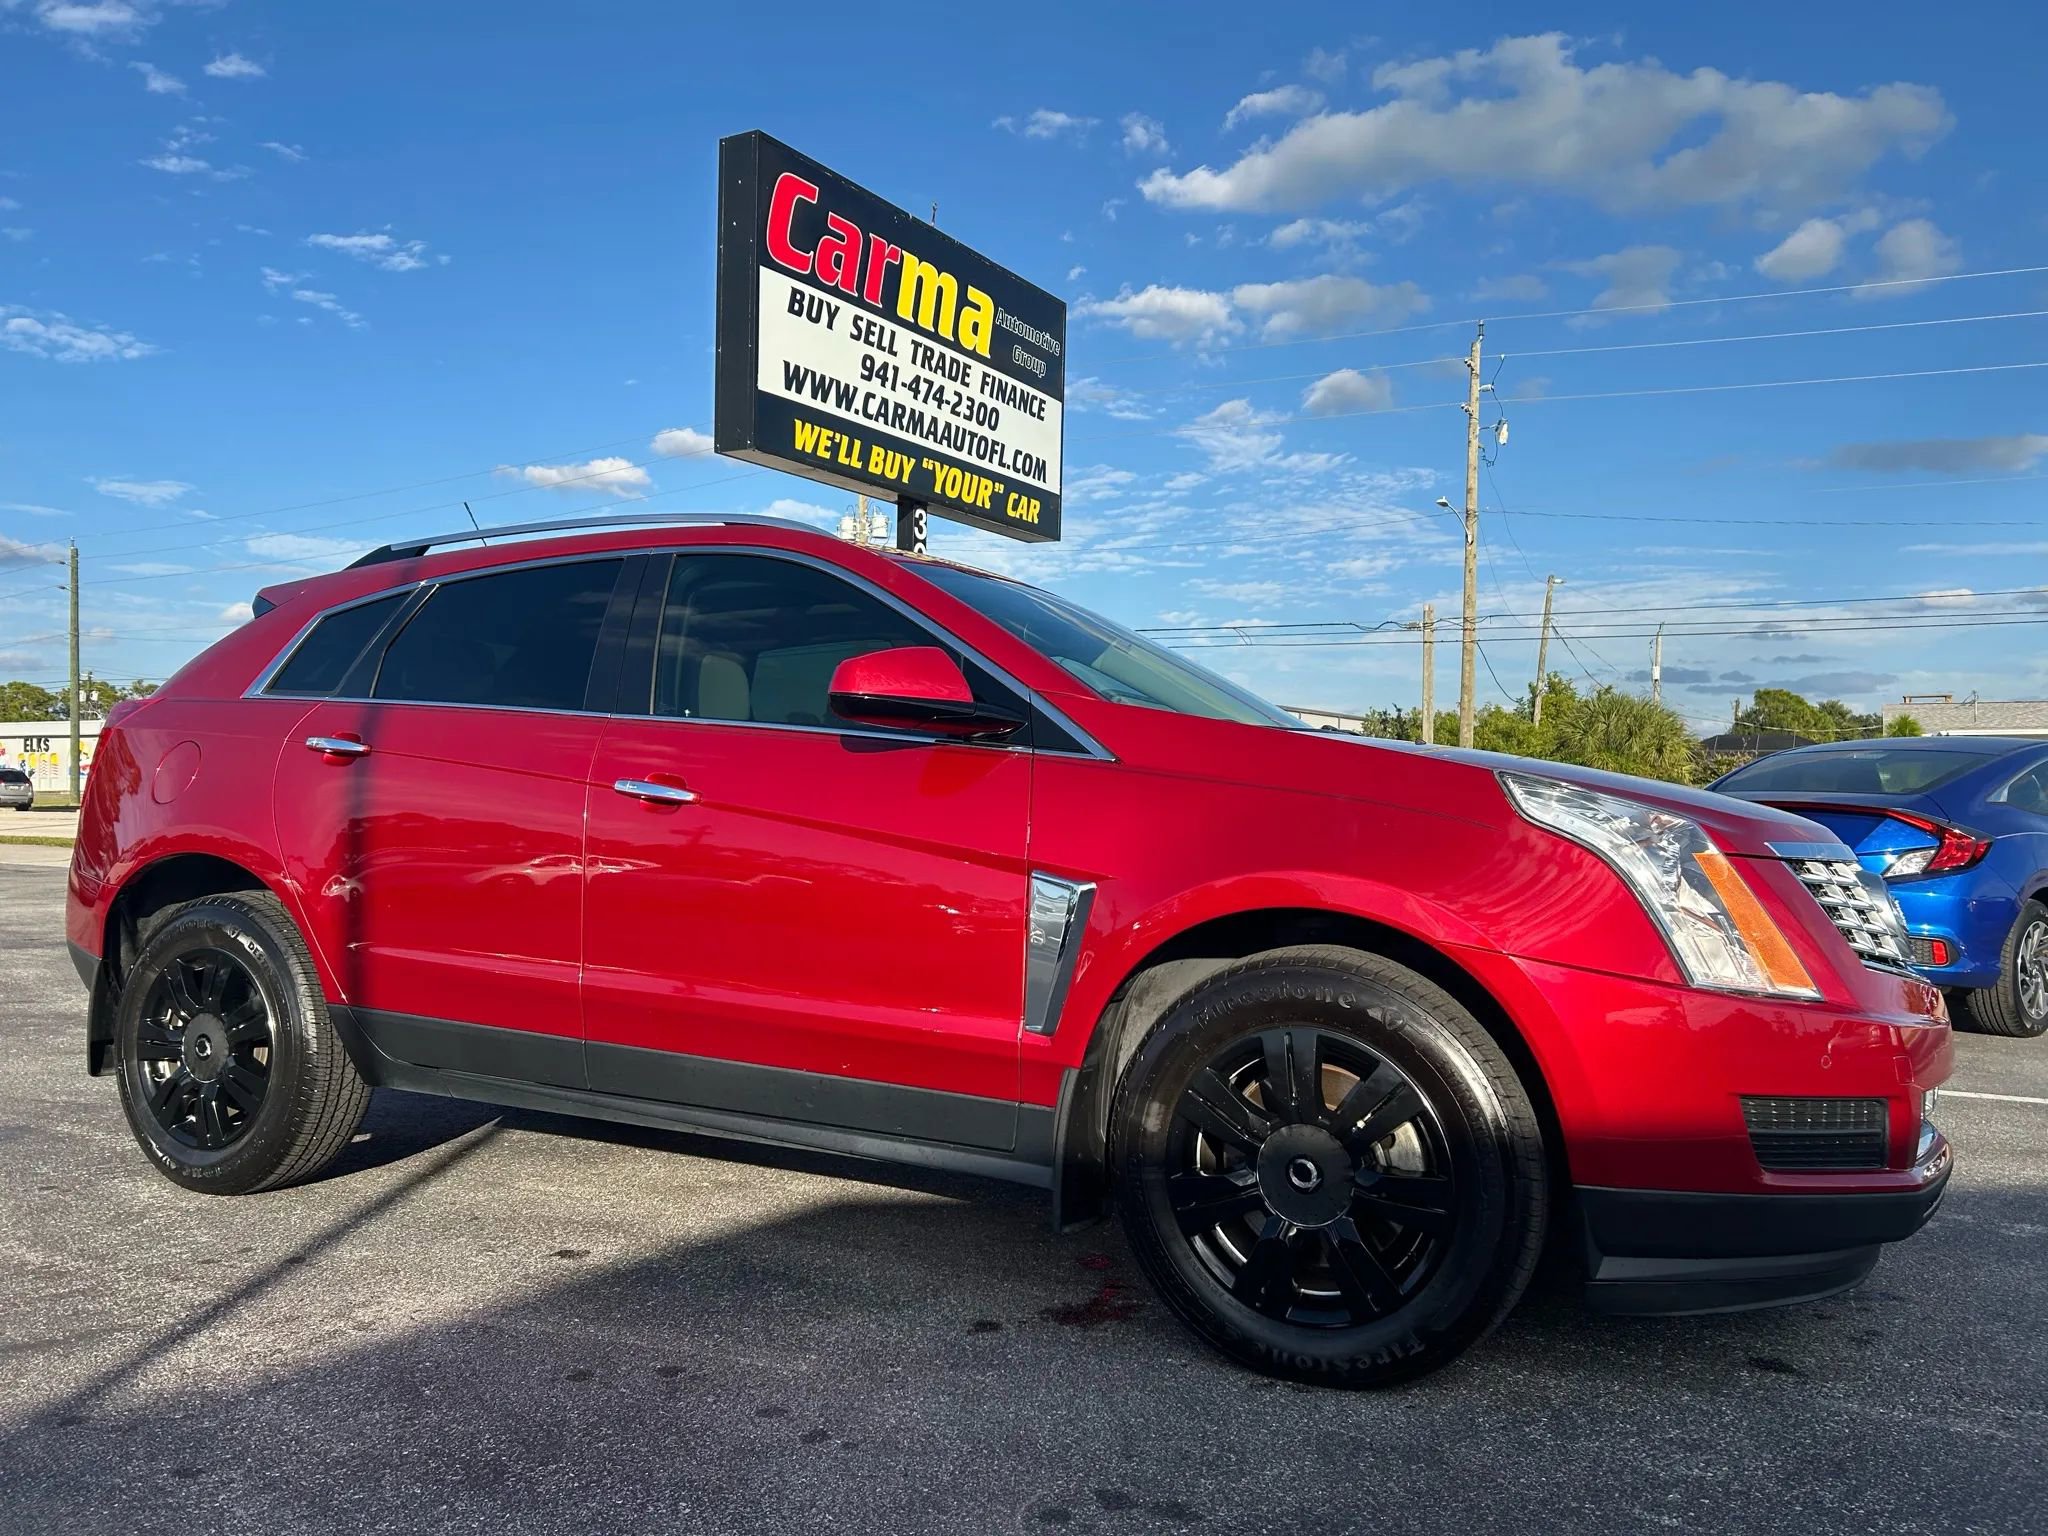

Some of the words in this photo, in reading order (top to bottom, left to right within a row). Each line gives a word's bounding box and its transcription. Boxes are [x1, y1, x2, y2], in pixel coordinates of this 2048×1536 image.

[766, 172, 995, 359] Carma
[787, 286, 840, 331] BUY
[850, 315, 898, 357] SELL
[911, 339, 972, 388] TRADE
[980, 370, 1047, 422] FINANCE
[996, 307, 1061, 357] Automotive
[1013, 344, 1048, 378] Group
[783, 360, 1048, 484] WWW.CARMAAUTOFL.COM
[860, 354, 1000, 432] 941-474-2300
[793, 418, 863, 469] WE'LL
[868, 444, 916, 484] BUY
[922, 457, 1005, 510] "YOUR"
[1006, 492, 1041, 524] CAR
[23, 737, 50, 753] ELKS
